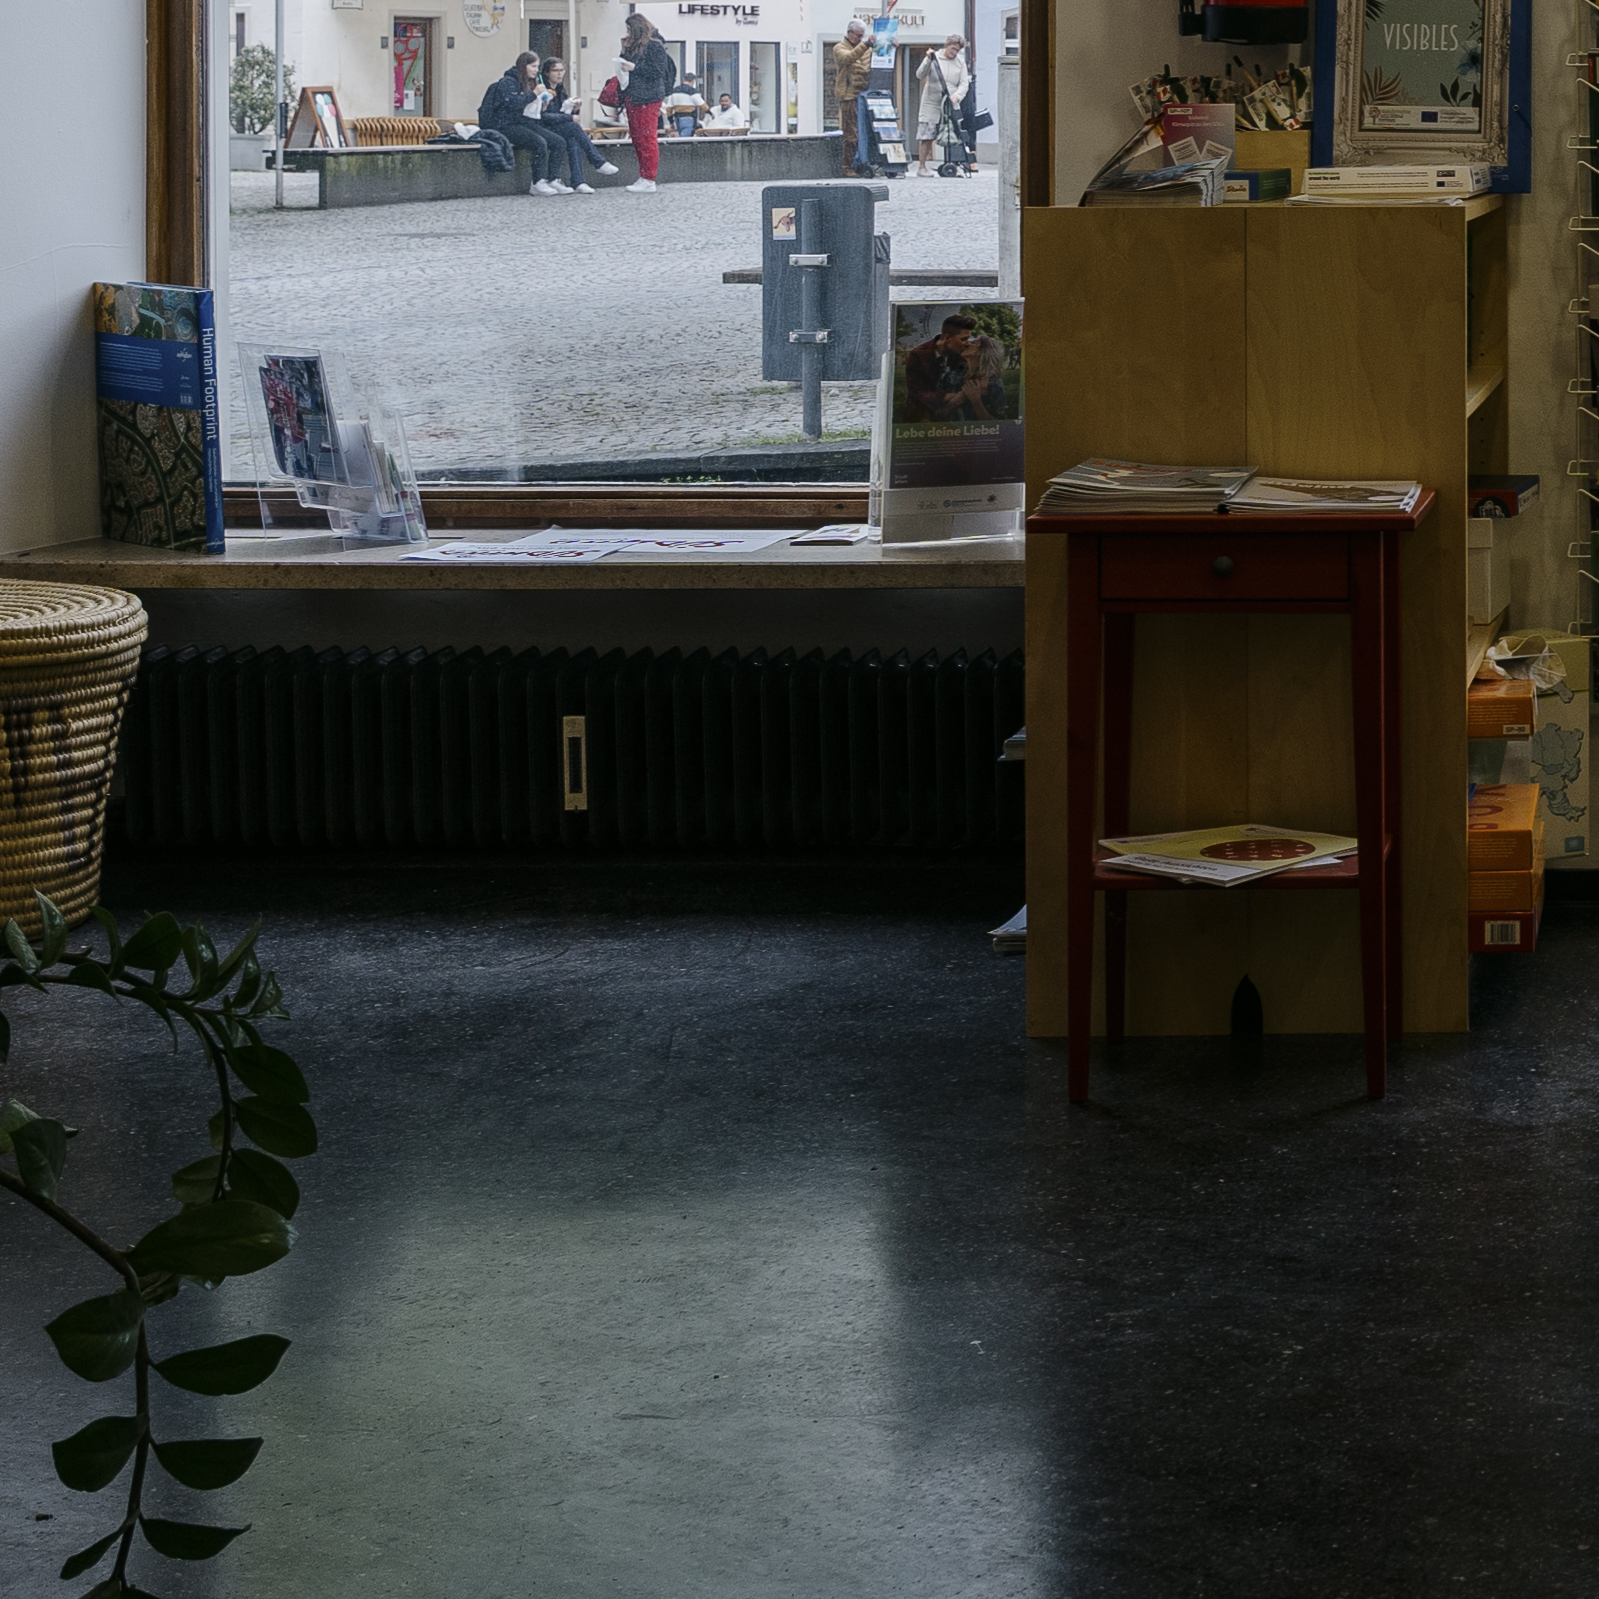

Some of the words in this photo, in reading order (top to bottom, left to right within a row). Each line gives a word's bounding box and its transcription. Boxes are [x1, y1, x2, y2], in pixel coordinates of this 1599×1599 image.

[679, 4, 761, 17] LIFESTYLE
[1383, 23, 1459, 51] VISIBLES
[202, 327, 214, 375] Human
[204, 382, 218, 441] Footprint
[895, 427, 926, 439] Lebe
[927, 426, 961, 437] deine
[963, 424, 1000, 436] Liebe!
